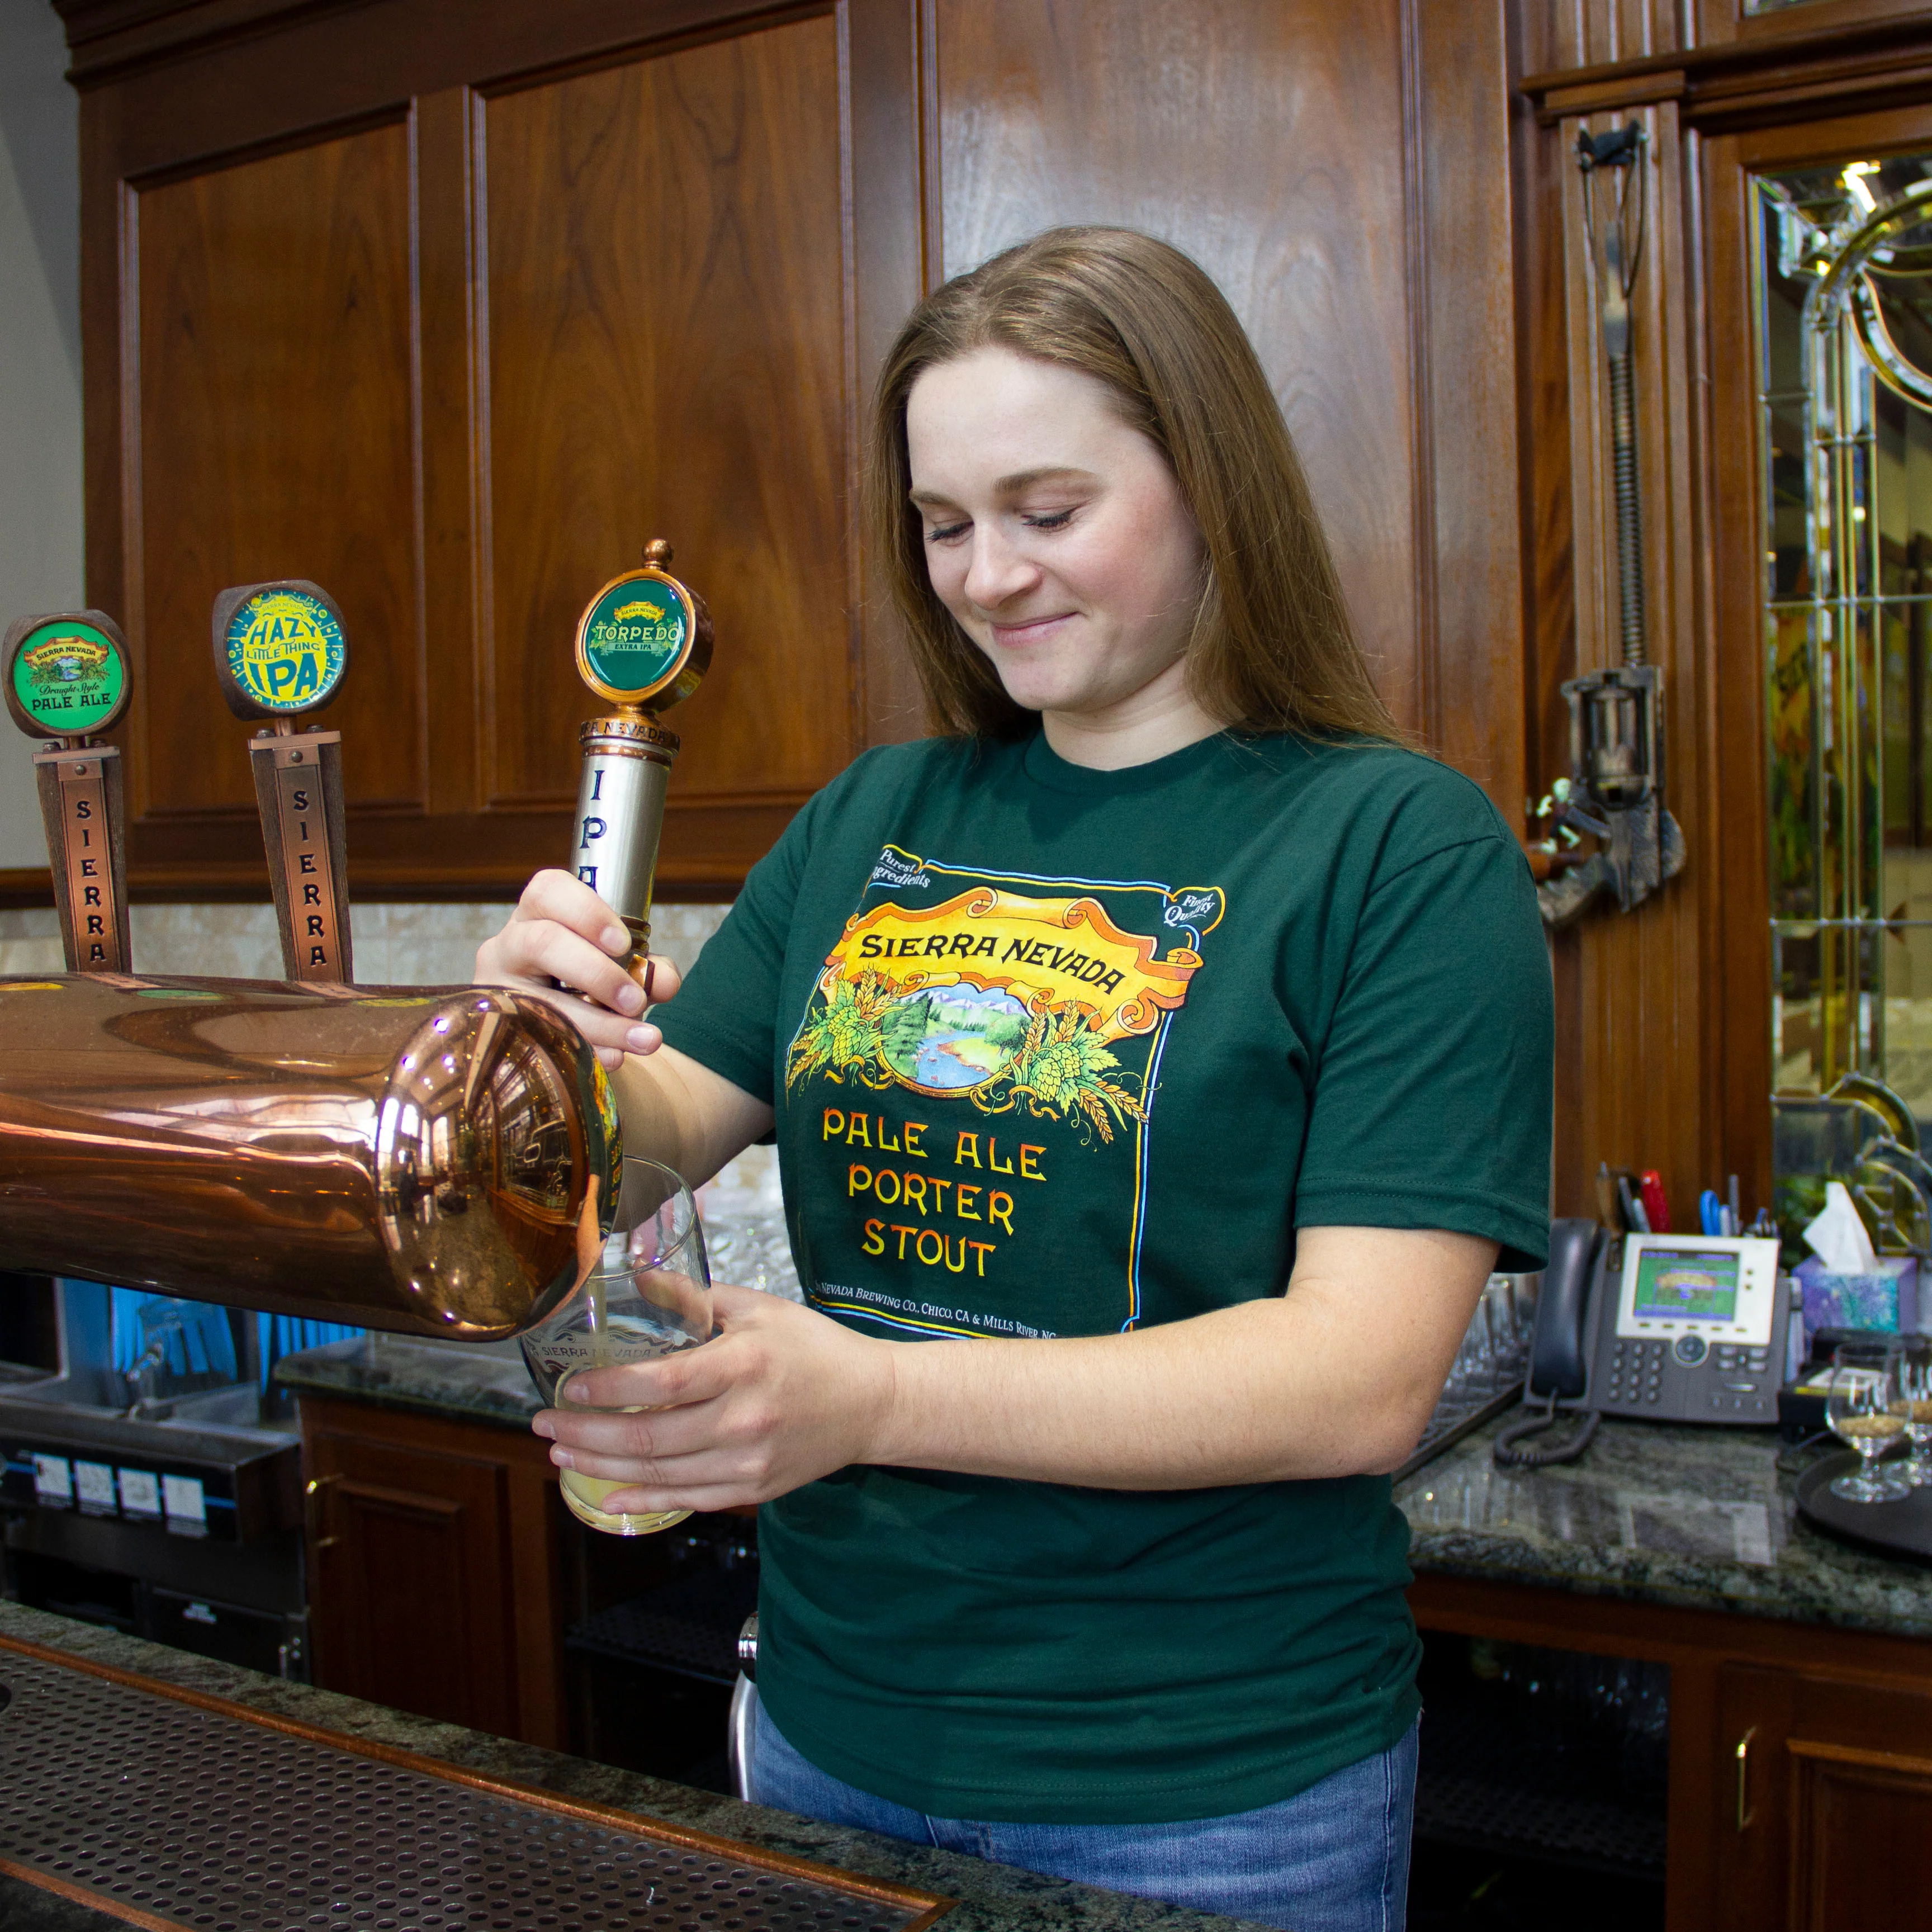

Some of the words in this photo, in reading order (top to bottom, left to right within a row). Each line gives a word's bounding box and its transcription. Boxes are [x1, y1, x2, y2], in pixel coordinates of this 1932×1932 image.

[261, 603, 281, 612] SIERRA
[621, 608, 639, 616] SIERRA
[639, 607, 658, 617] NEVADA
[249, 617, 317, 645] HAZY
[595, 625, 680, 642] TORPEDO
[36, 646, 64, 661] SIERRA
[65, 645, 96, 657] NEVADA
[246, 645, 281, 660] LITTLE
[279, 638, 321, 655] THING
[245, 652, 319, 697] IPA
[40, 684, 77, 696] Draught
[78, 682, 100, 694] Style
[32, 696, 73, 711] PALE
[80, 693, 112, 707] ALE
[604, 721, 666, 742] NEVADA
[879, 849, 916, 873] Purest
[76, 800, 107, 962] SIERRA
[293, 790, 327, 967] SIERRA
[1181, 893, 1214, 907] Finest
[1163, 902, 1216, 927] Quality
[858, 934, 998, 960] SIERRA
[1001, 933, 1126, 995] NEVADA
[822, 1107, 929, 1158] PALE
[954, 1130, 1048, 1182] ALE
[848, 1162, 1015, 1237] PORTER
[861, 1218, 997, 1277] STOUT
[821, 1282, 854, 1298] NEVADA
[855, 1287, 901, 1309] BREWING
[955, 1309, 970, 1323] CA
[972, 1314, 981, 1325] &
[983, 1315, 1014, 1332] MILLS
[541, 1346, 588, 1357] SIERRA
